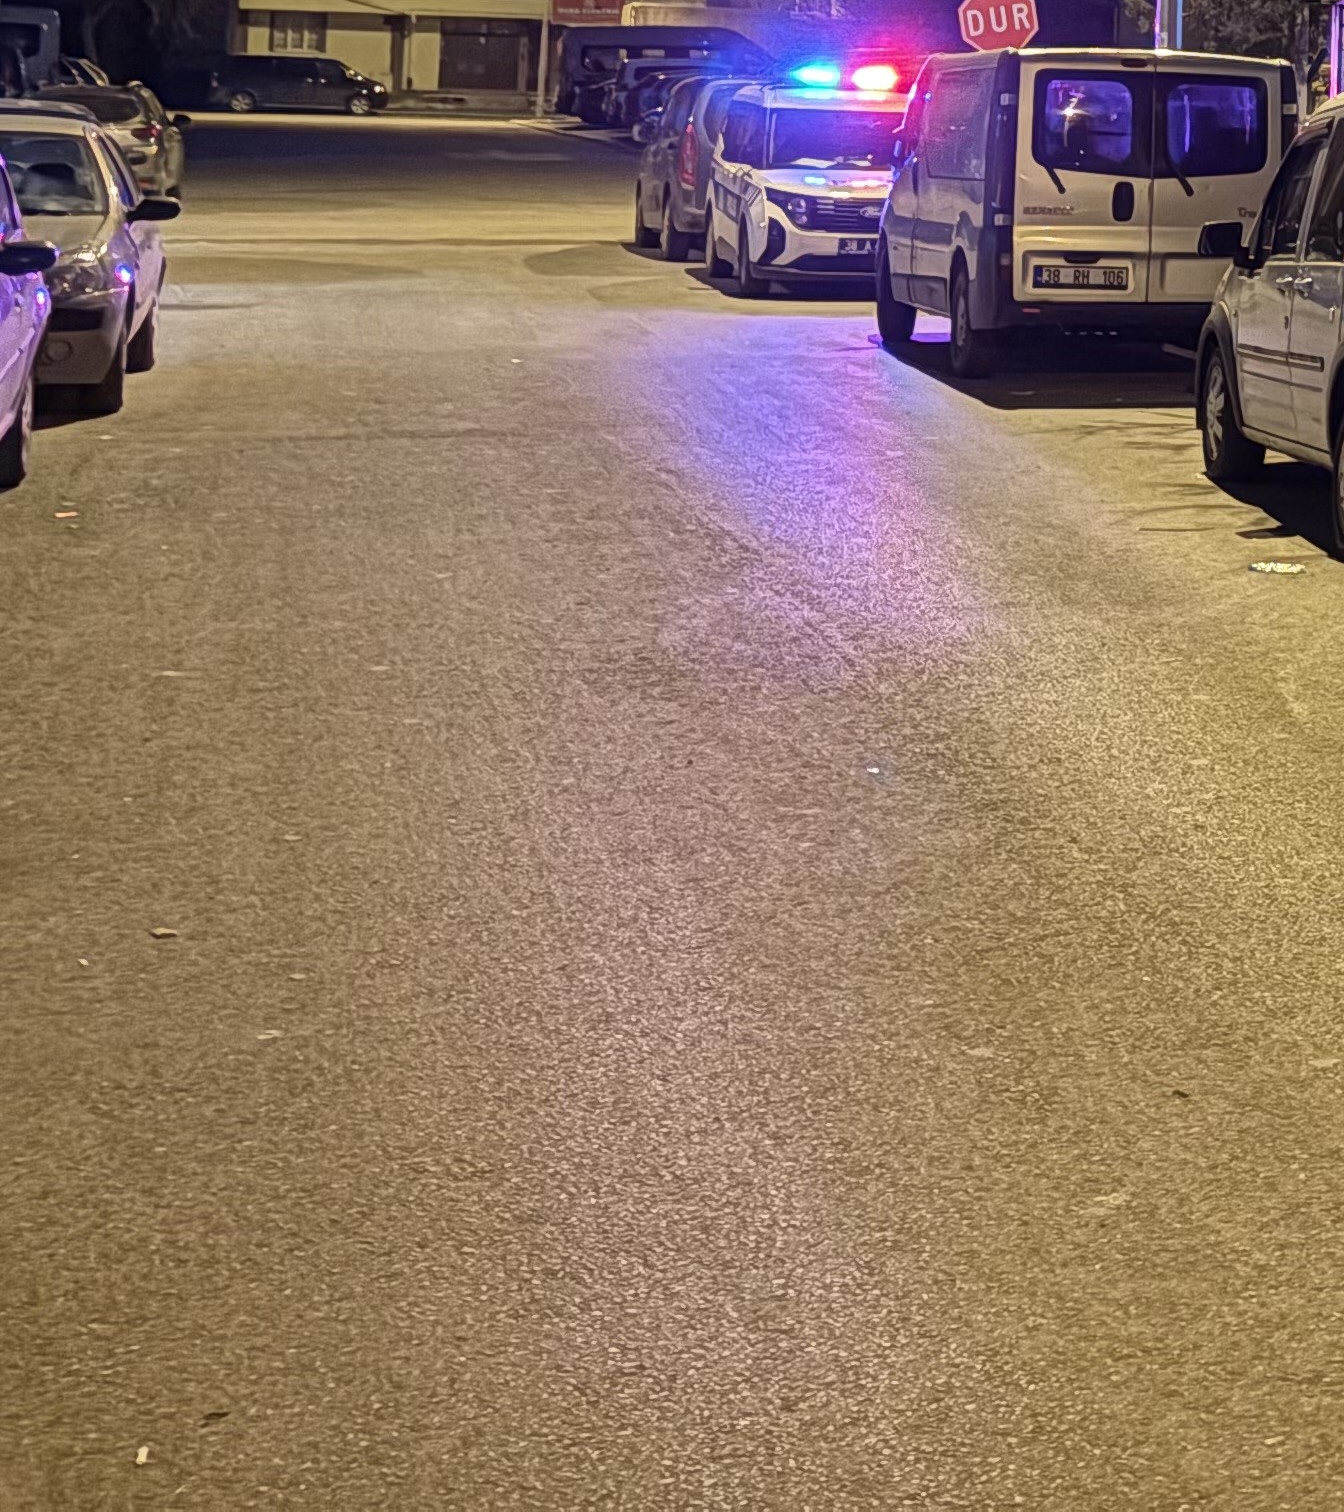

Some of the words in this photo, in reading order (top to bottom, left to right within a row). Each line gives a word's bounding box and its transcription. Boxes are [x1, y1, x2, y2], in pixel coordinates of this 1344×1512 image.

[967, 3, 1031, 36] DUR
[1045, 269, 1061, 284] 38
[1073, 270, 1090, 285] RH
[1103, 270, 1125, 286] 106
